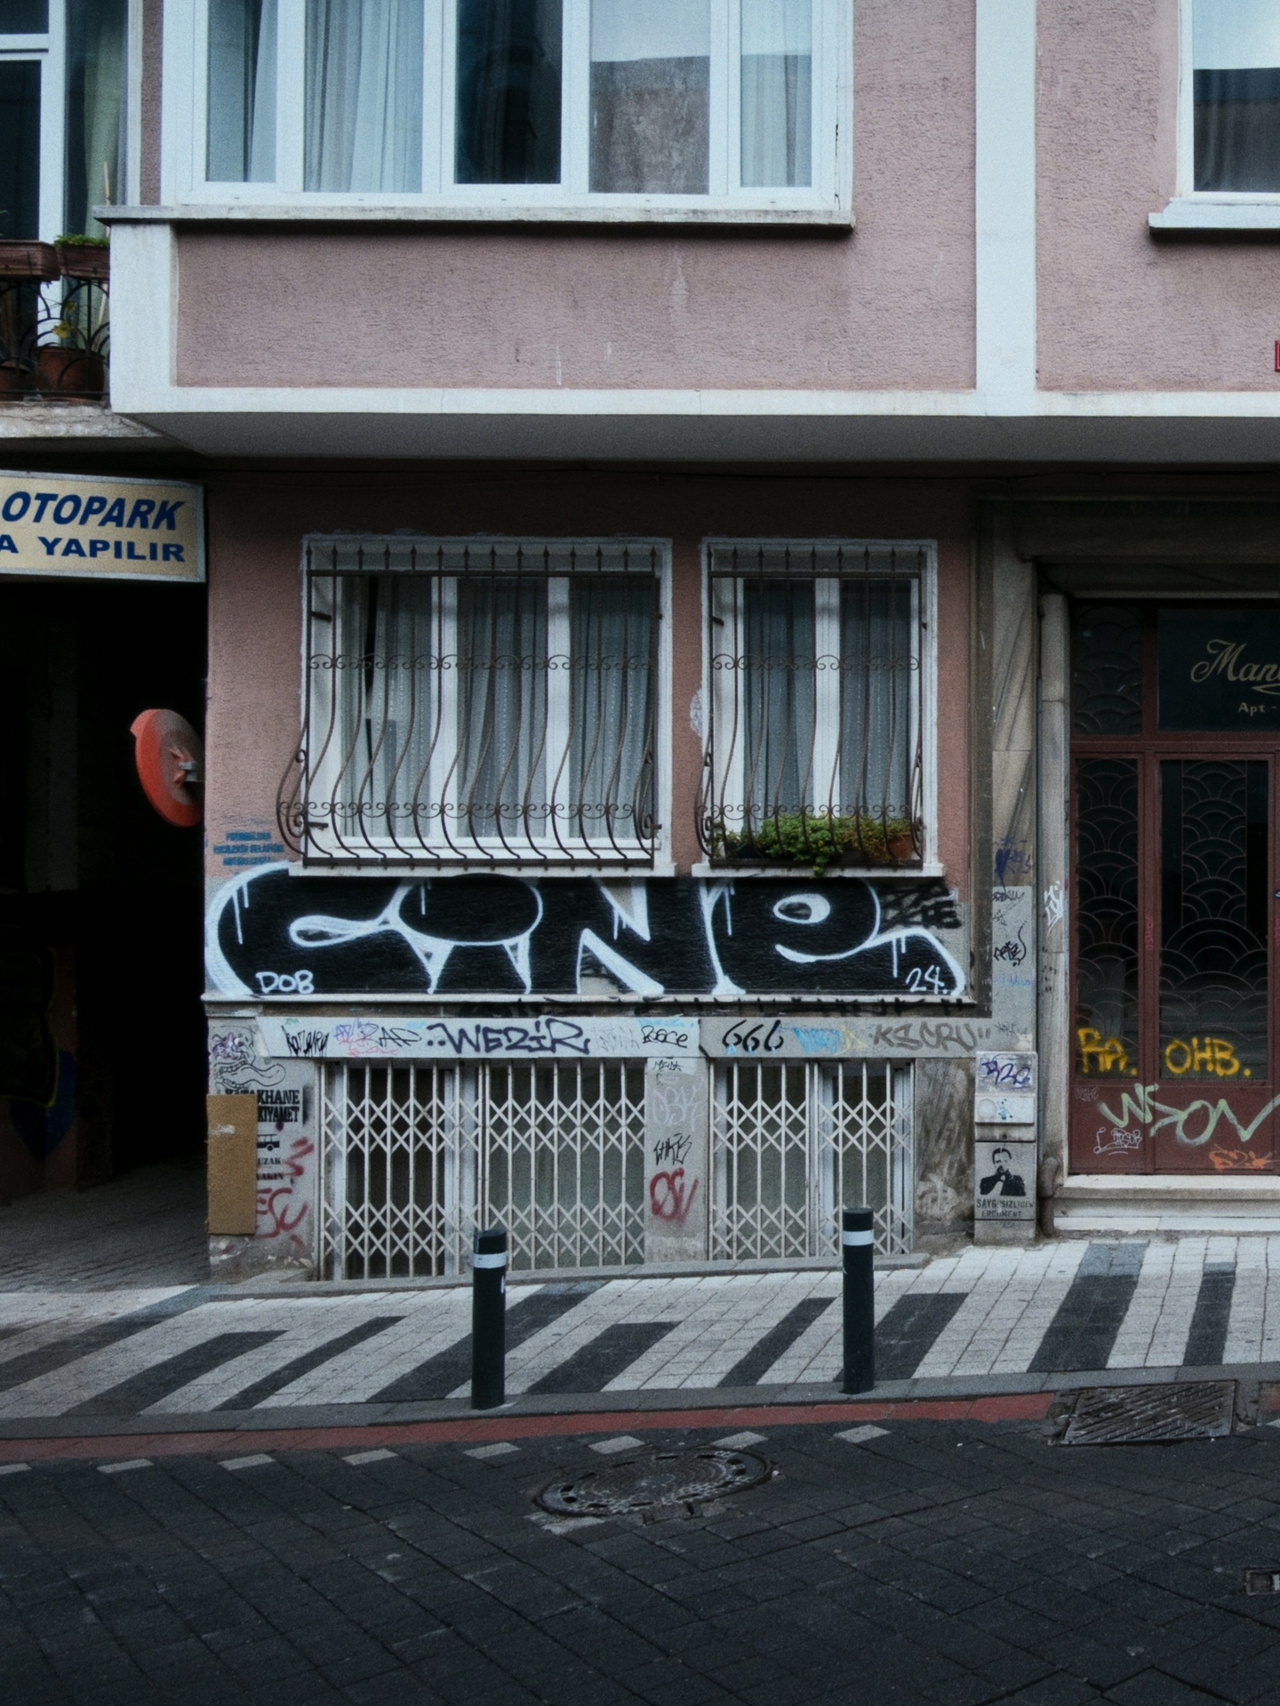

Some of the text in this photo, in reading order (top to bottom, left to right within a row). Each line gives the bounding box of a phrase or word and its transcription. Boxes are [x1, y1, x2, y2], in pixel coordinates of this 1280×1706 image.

[1, 491, 185, 531] OTOPARK
[37, 536, 186, 563] YAPILIR
[1237, 701, 1267, 717] Apt
[255, 969, 315, 995] DOB
[721, 1019, 785, 1052] 666
